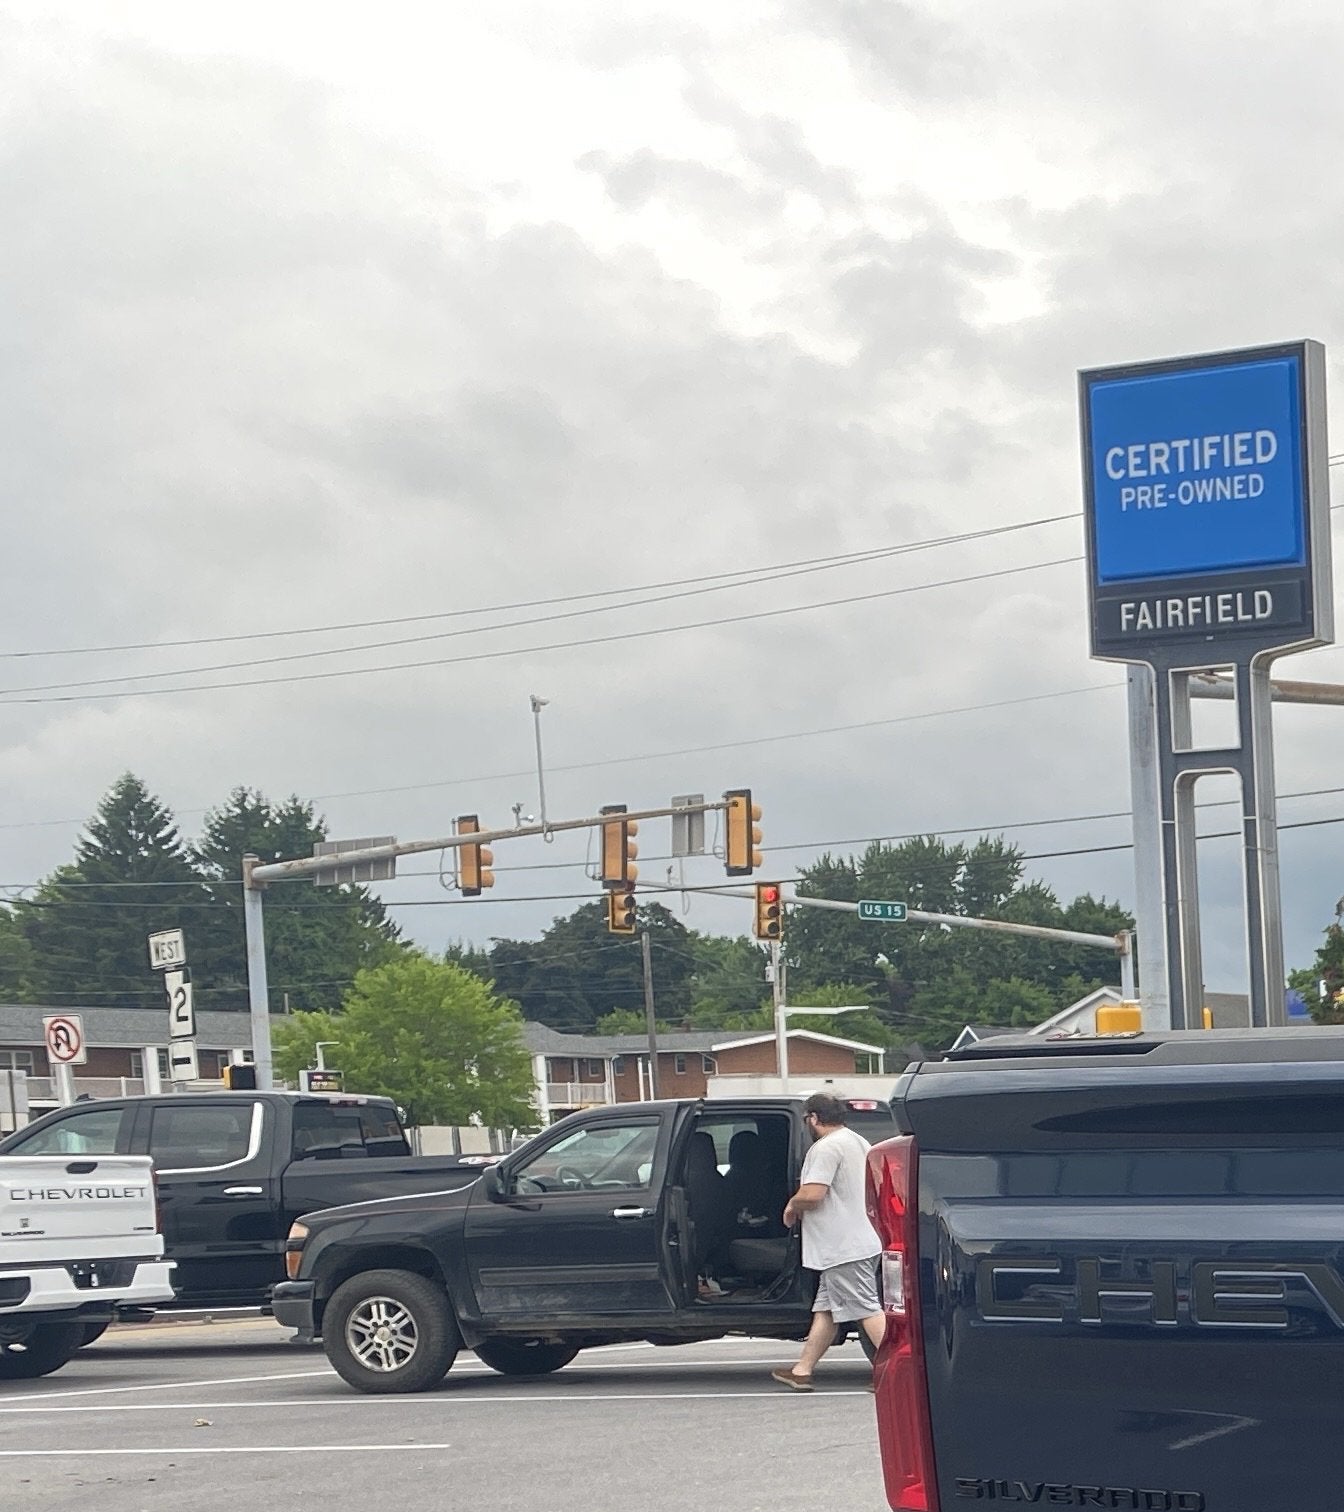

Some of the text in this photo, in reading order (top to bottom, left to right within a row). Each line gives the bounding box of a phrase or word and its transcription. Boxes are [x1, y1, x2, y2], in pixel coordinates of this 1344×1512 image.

[1105, 429, 1278, 480] CERTIFIED
[1121, 473, 1265, 512] PRE-OWNED
[1120, 590, 1273, 631] FAIRFIELD
[864, 904, 902, 917] US 15
[153, 939, 180, 961] WEST
[9, 1187, 147, 1201] CHEVROLET
